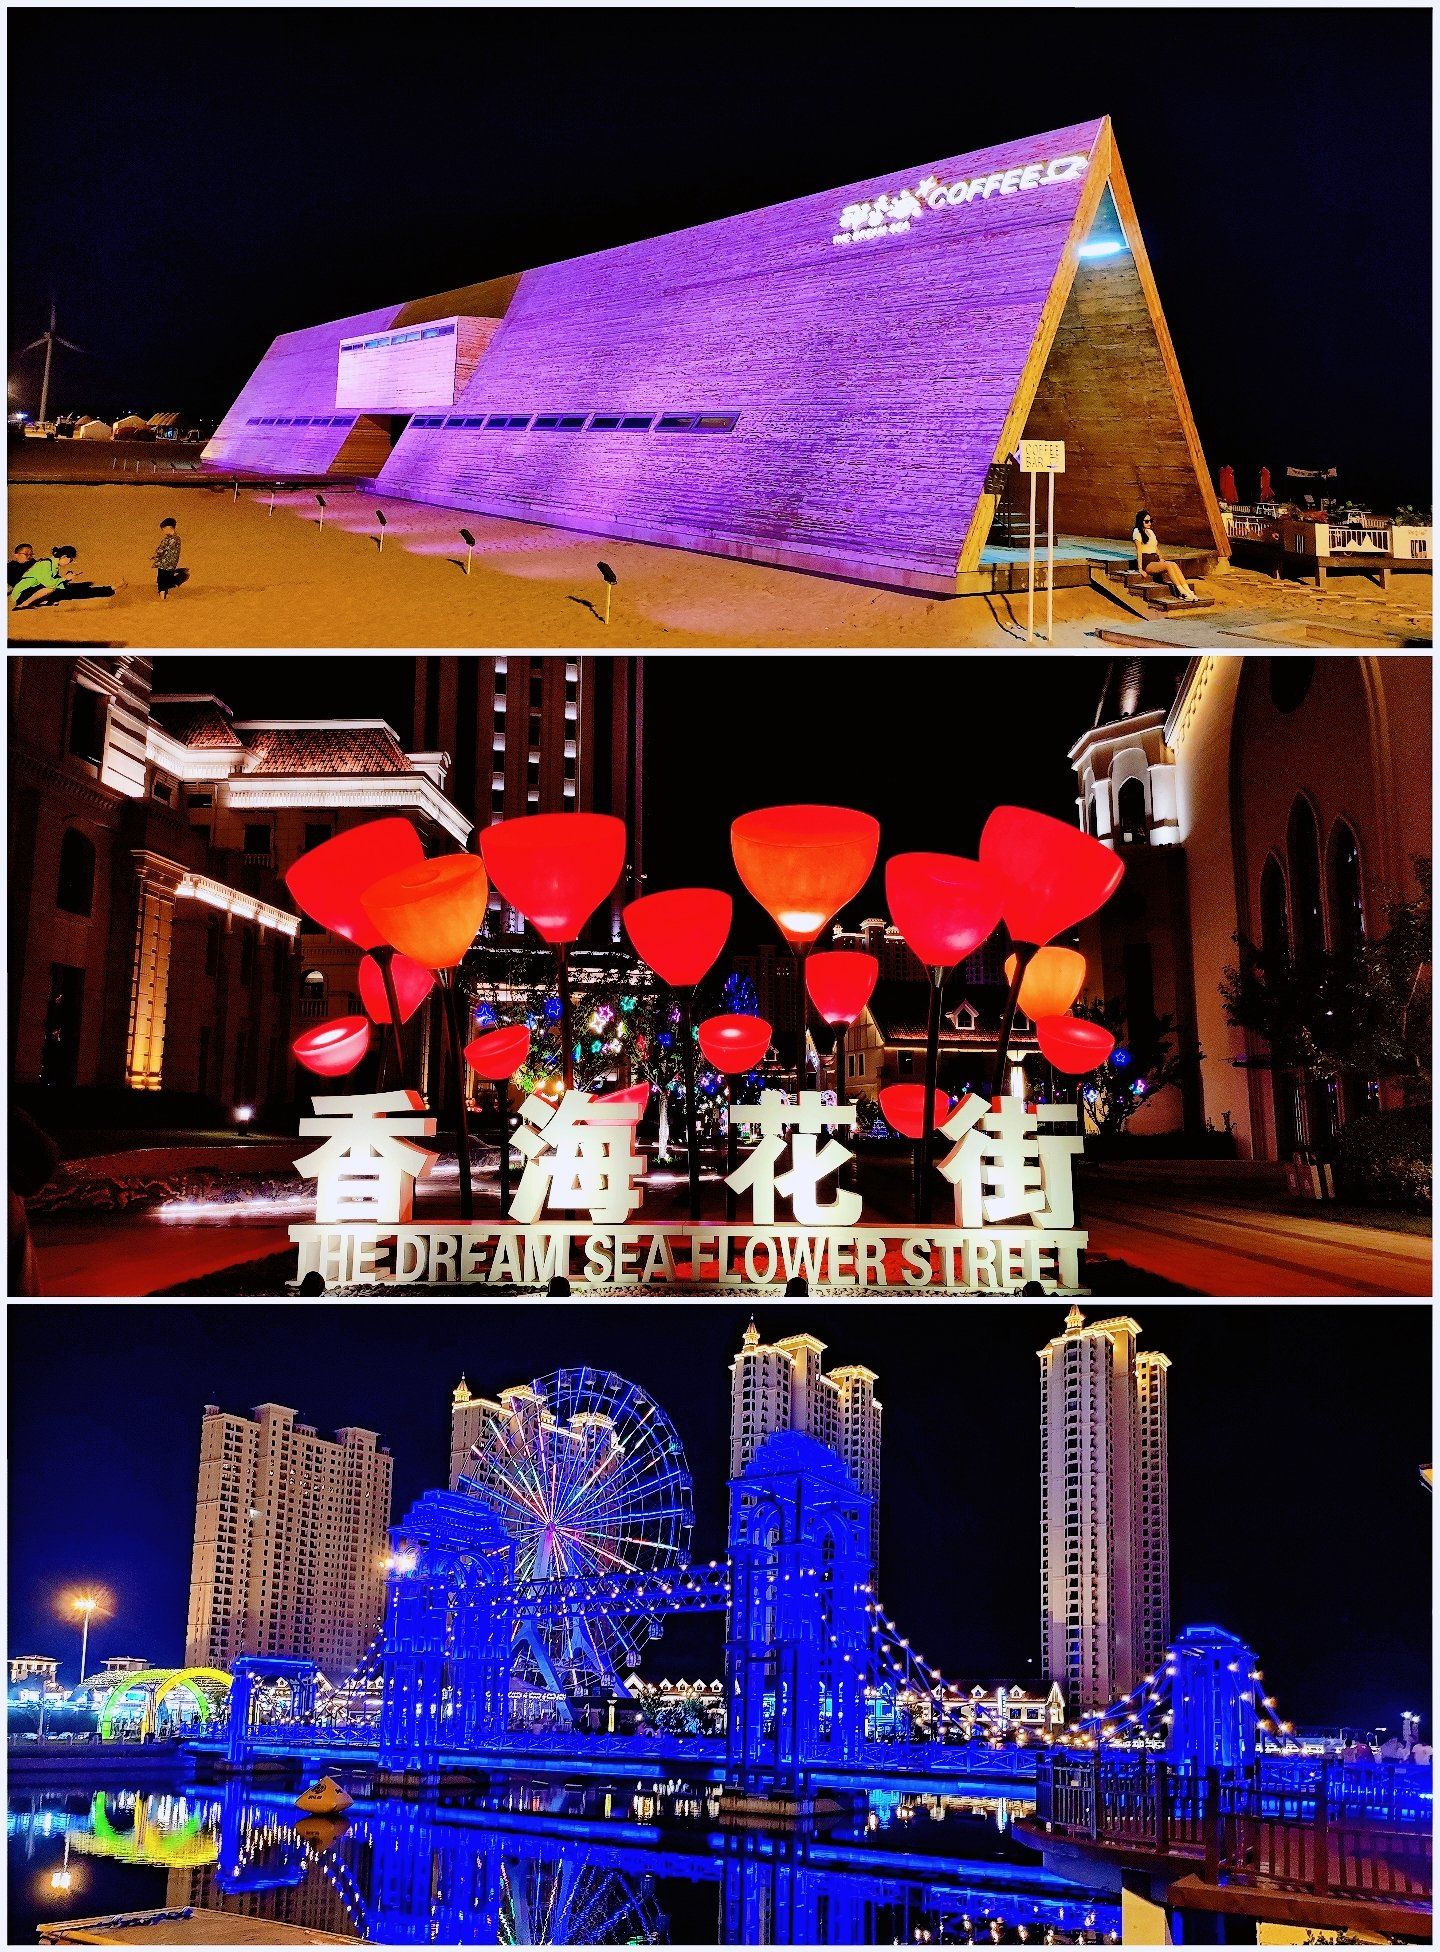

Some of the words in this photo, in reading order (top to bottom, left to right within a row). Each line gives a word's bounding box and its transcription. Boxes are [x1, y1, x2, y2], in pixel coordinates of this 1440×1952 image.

[927, 164, 1044, 210] COFFEE
[1026, 443, 1059, 456] COFFEE
[1026, 456, 1044, 468] BAR
[292, 1090, 1084, 1228] 香海花街
[288, 1227, 391, 1285] THE
[396, 1233, 571, 1283] DREAM
[583, 1234, 677, 1283] SEA
[691, 1234, 888, 1286] FLOWER
[901, 1236, 1088, 1290] STREET
